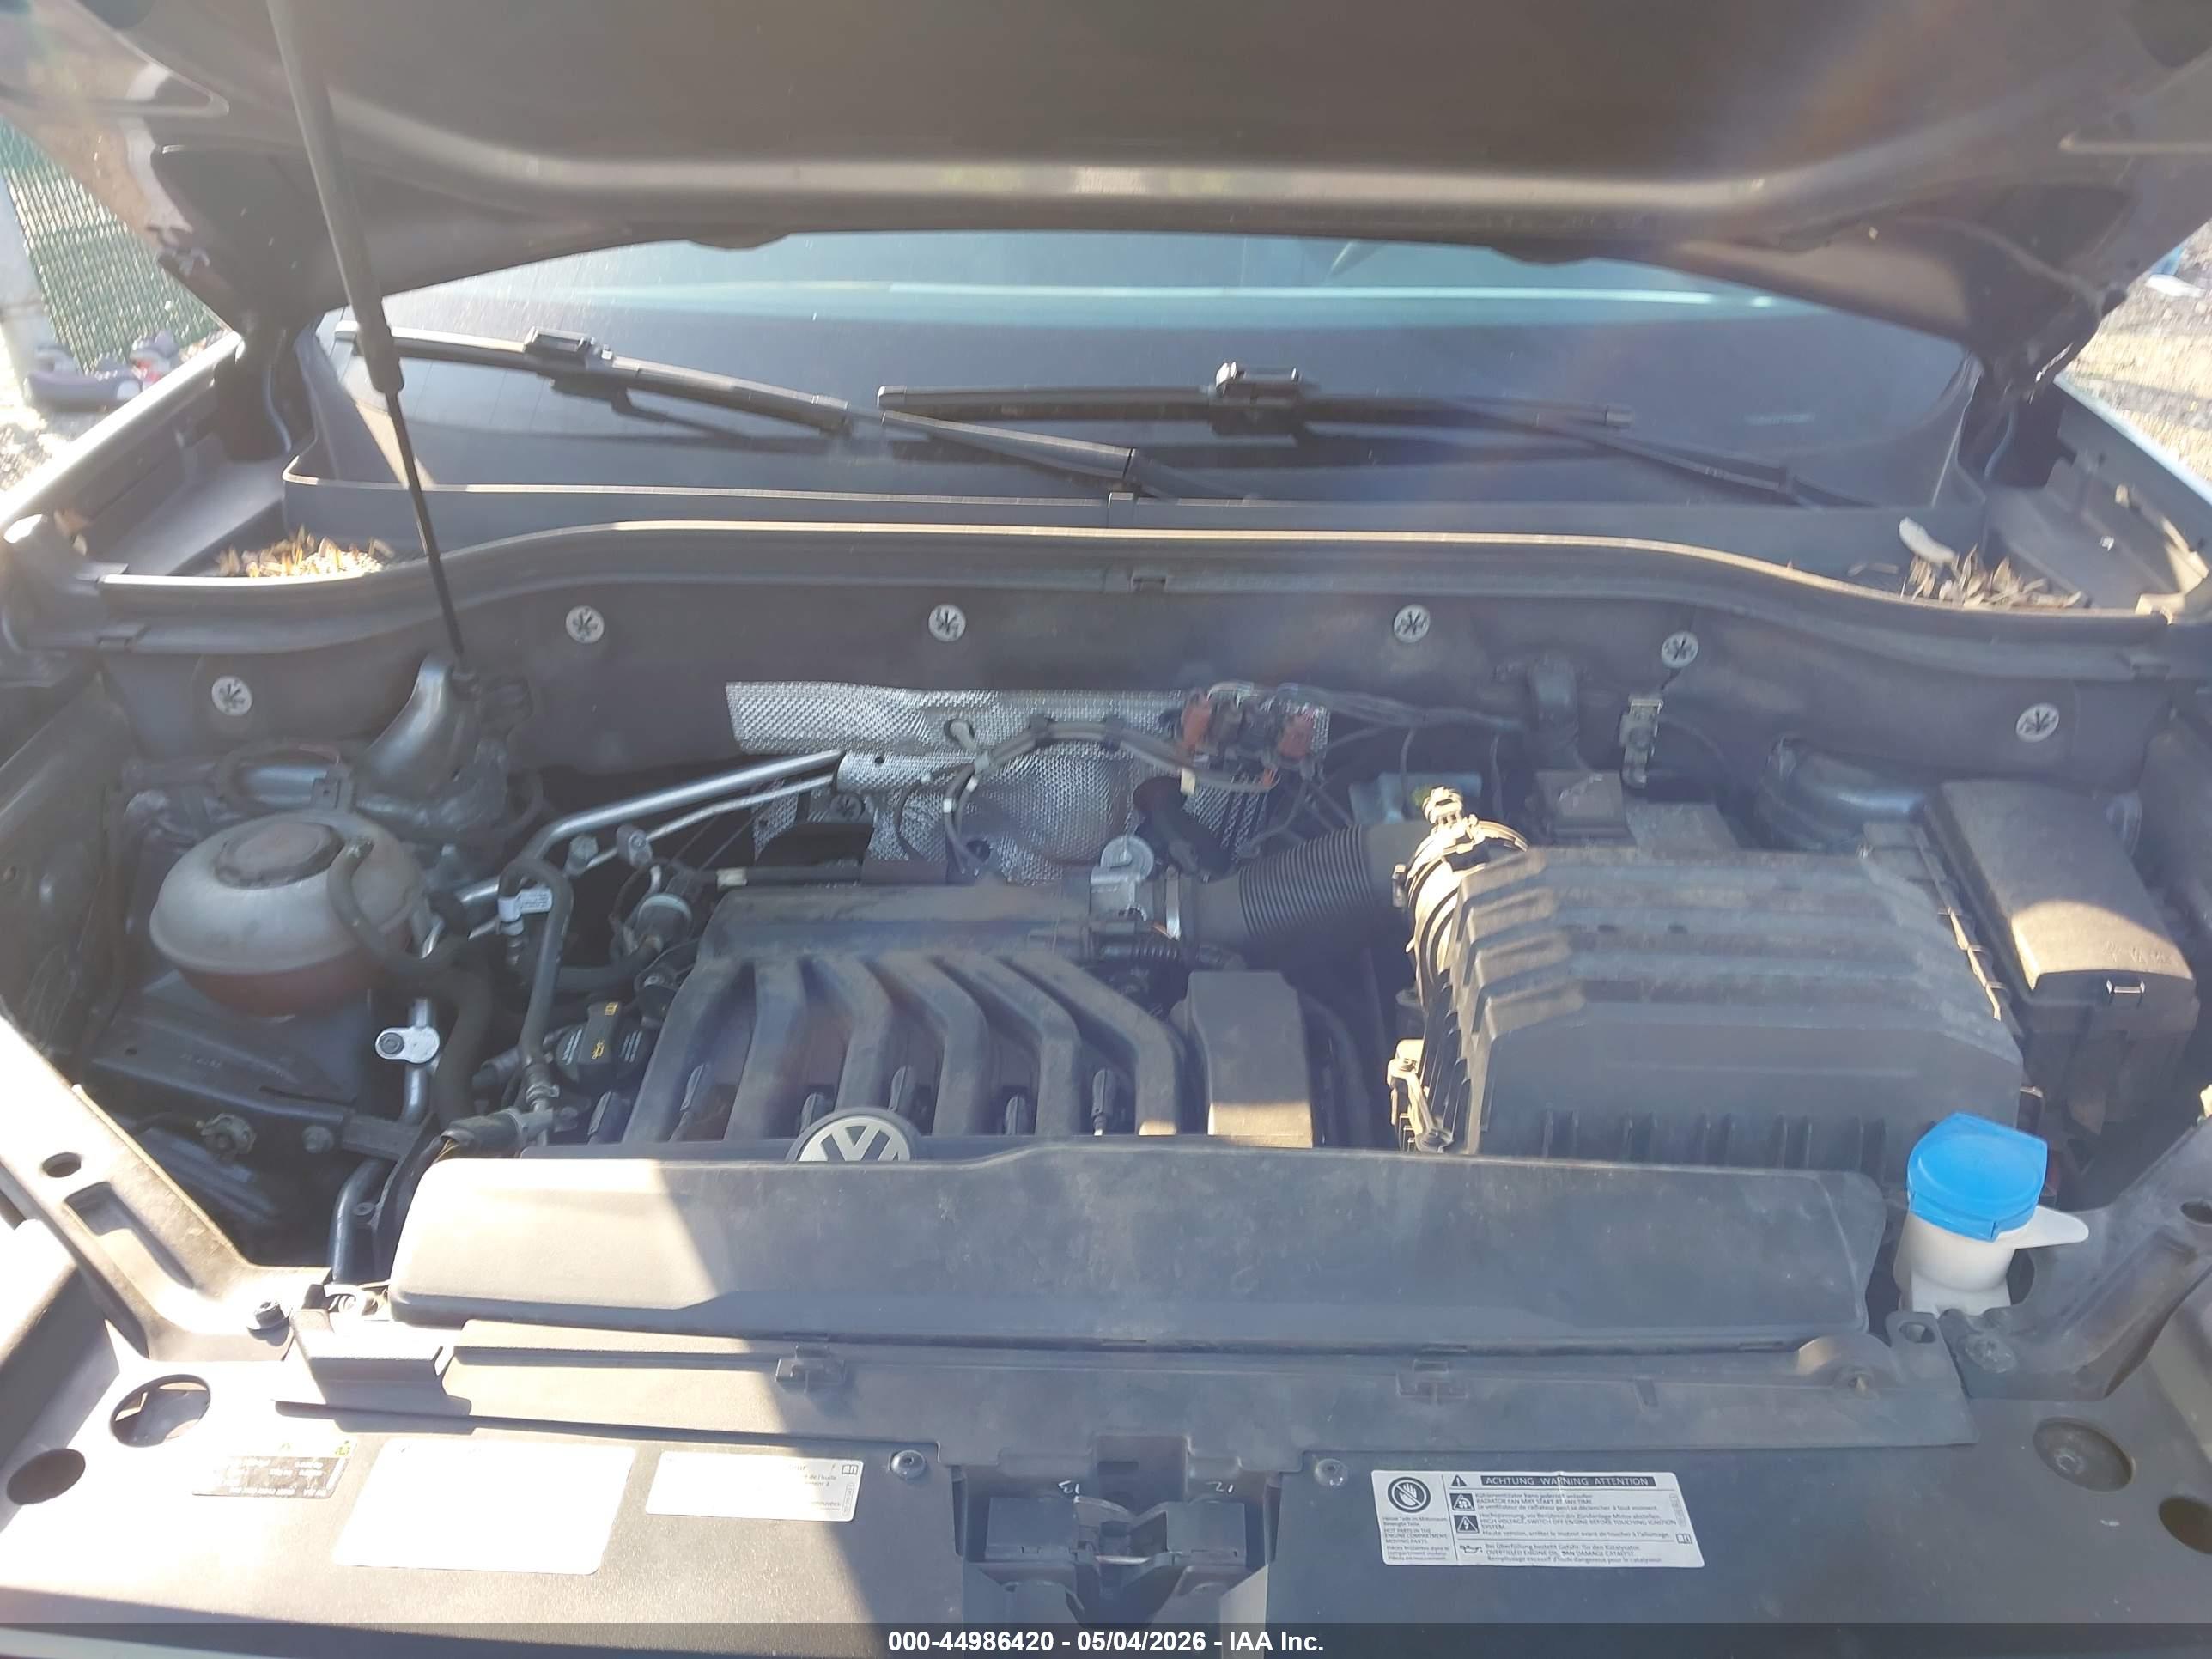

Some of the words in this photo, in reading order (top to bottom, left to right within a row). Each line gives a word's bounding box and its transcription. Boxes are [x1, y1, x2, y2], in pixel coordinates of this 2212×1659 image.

[1485, 1477, 1535, 1486] ACHTUNG
[1539, 1477, 1589, 1486] WARNING
[1594, 1478, 1650, 1486] ATTENTION
